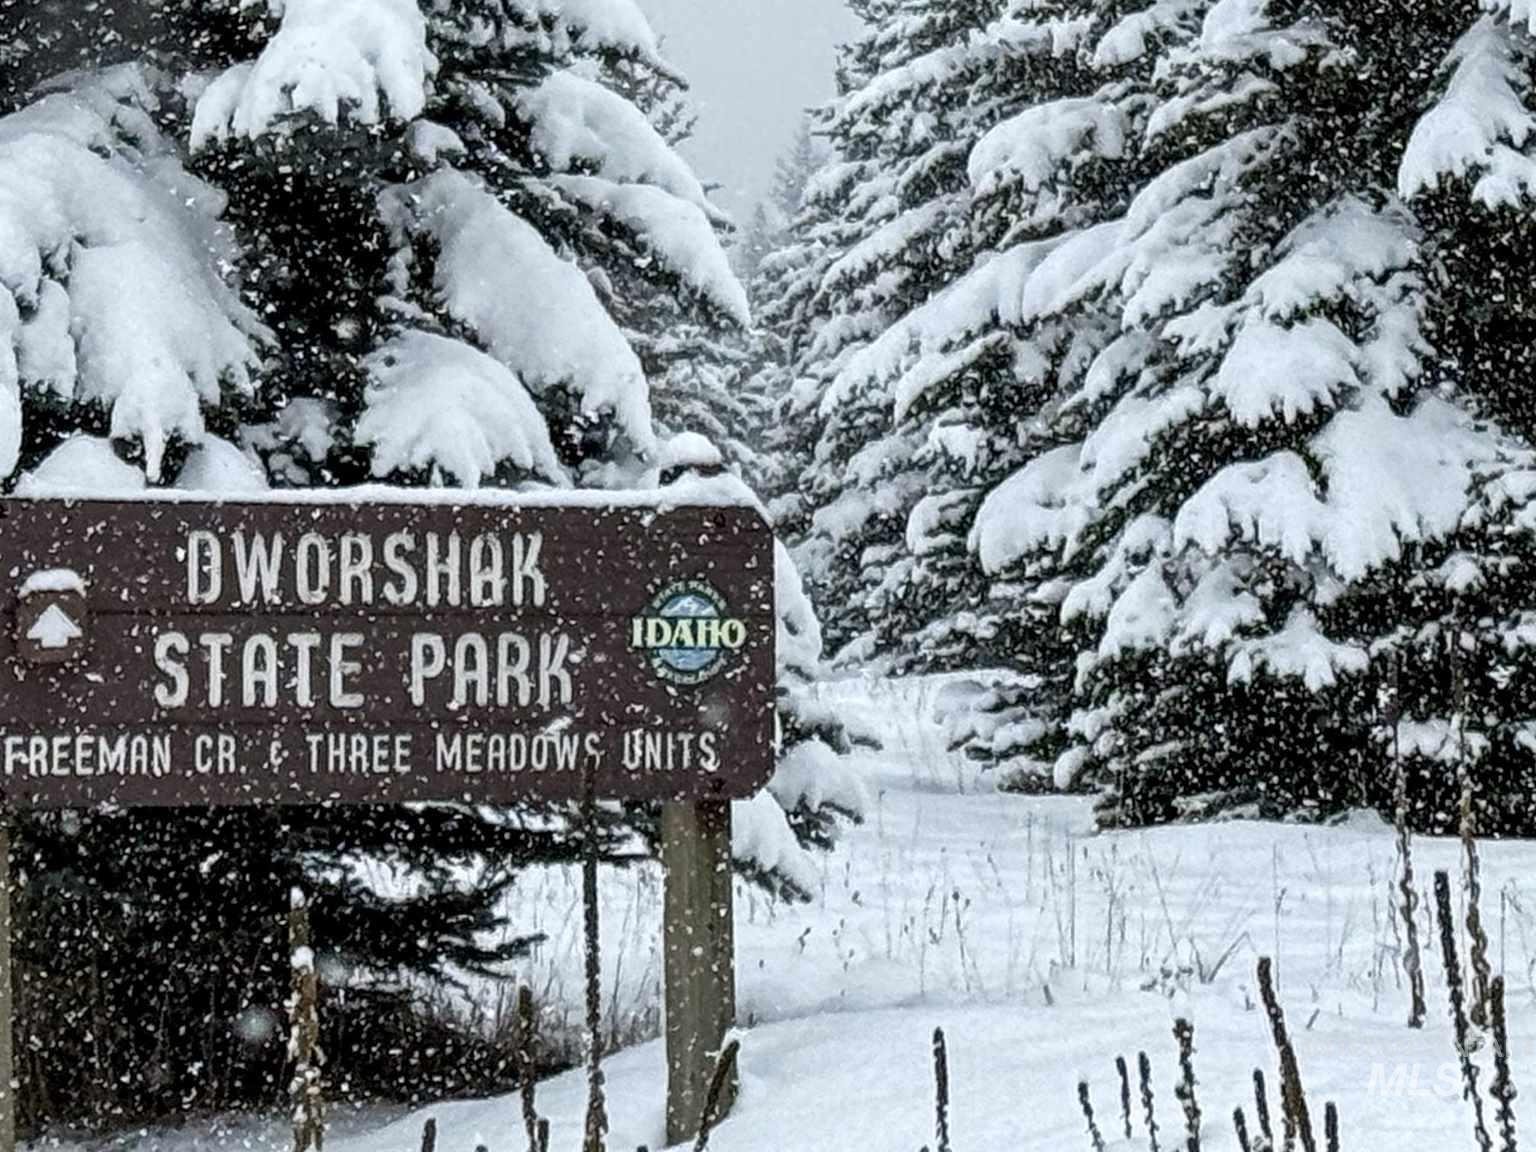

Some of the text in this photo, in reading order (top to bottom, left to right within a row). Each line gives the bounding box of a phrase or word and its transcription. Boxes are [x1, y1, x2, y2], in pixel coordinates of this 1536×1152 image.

[187, 529, 547, 607] DWORSHAK
[632, 617, 746, 648] IDAHO
[154, 632, 365, 708] STATE
[410, 632, 573, 710] PARK
[4, 733, 171, 777] FREEMAN
[305, 733, 412, 774] THREE
[435, 732, 601, 772] MEADOWS
[623, 730, 719, 772] UNITS
